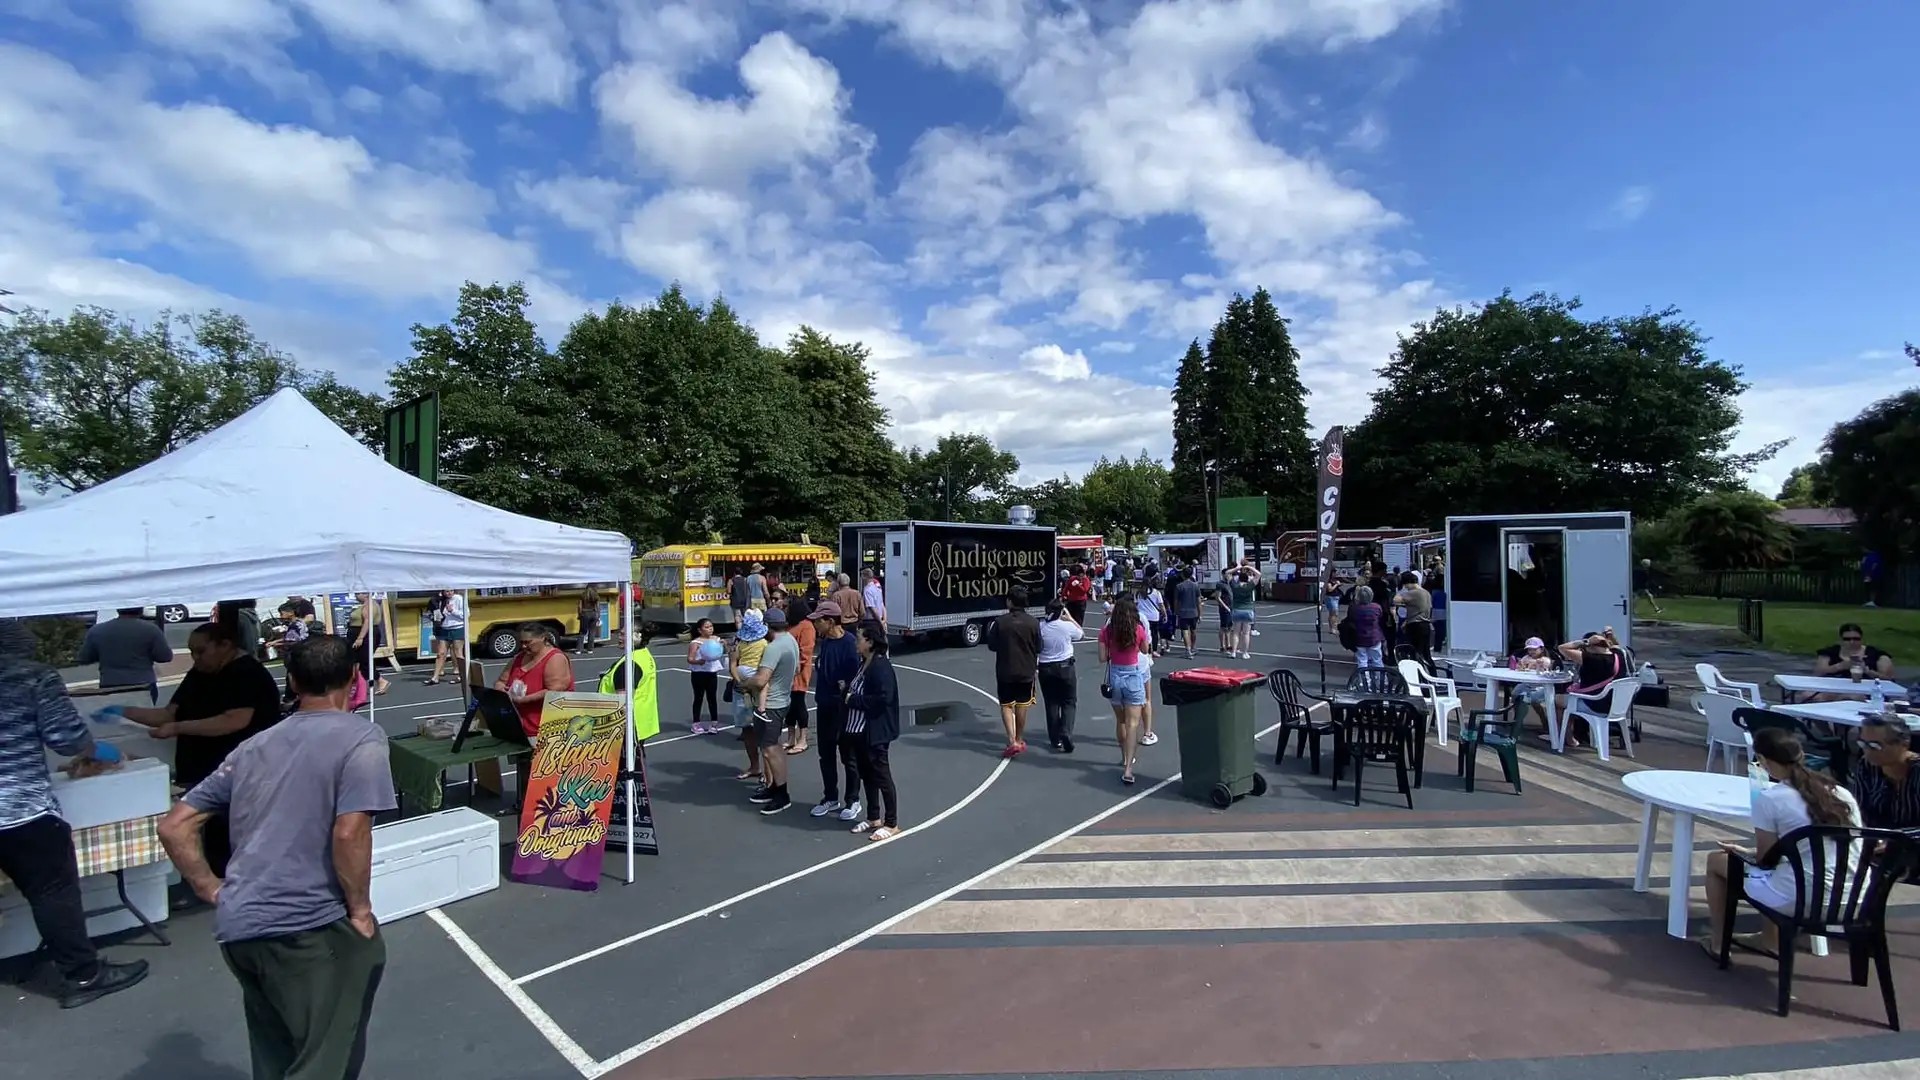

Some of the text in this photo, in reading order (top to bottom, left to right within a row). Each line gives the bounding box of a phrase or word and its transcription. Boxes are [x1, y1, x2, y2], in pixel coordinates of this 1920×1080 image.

[946, 543, 1046, 577] Indigenous
[690, 593, 713, 602] HOT
[946, 573, 1009, 598] Fusion
[532, 727, 622, 779] Island
[558, 763, 614, 809] Kai
[549, 807, 580, 826] and
[518, 822, 606, 860] Doughnuts
